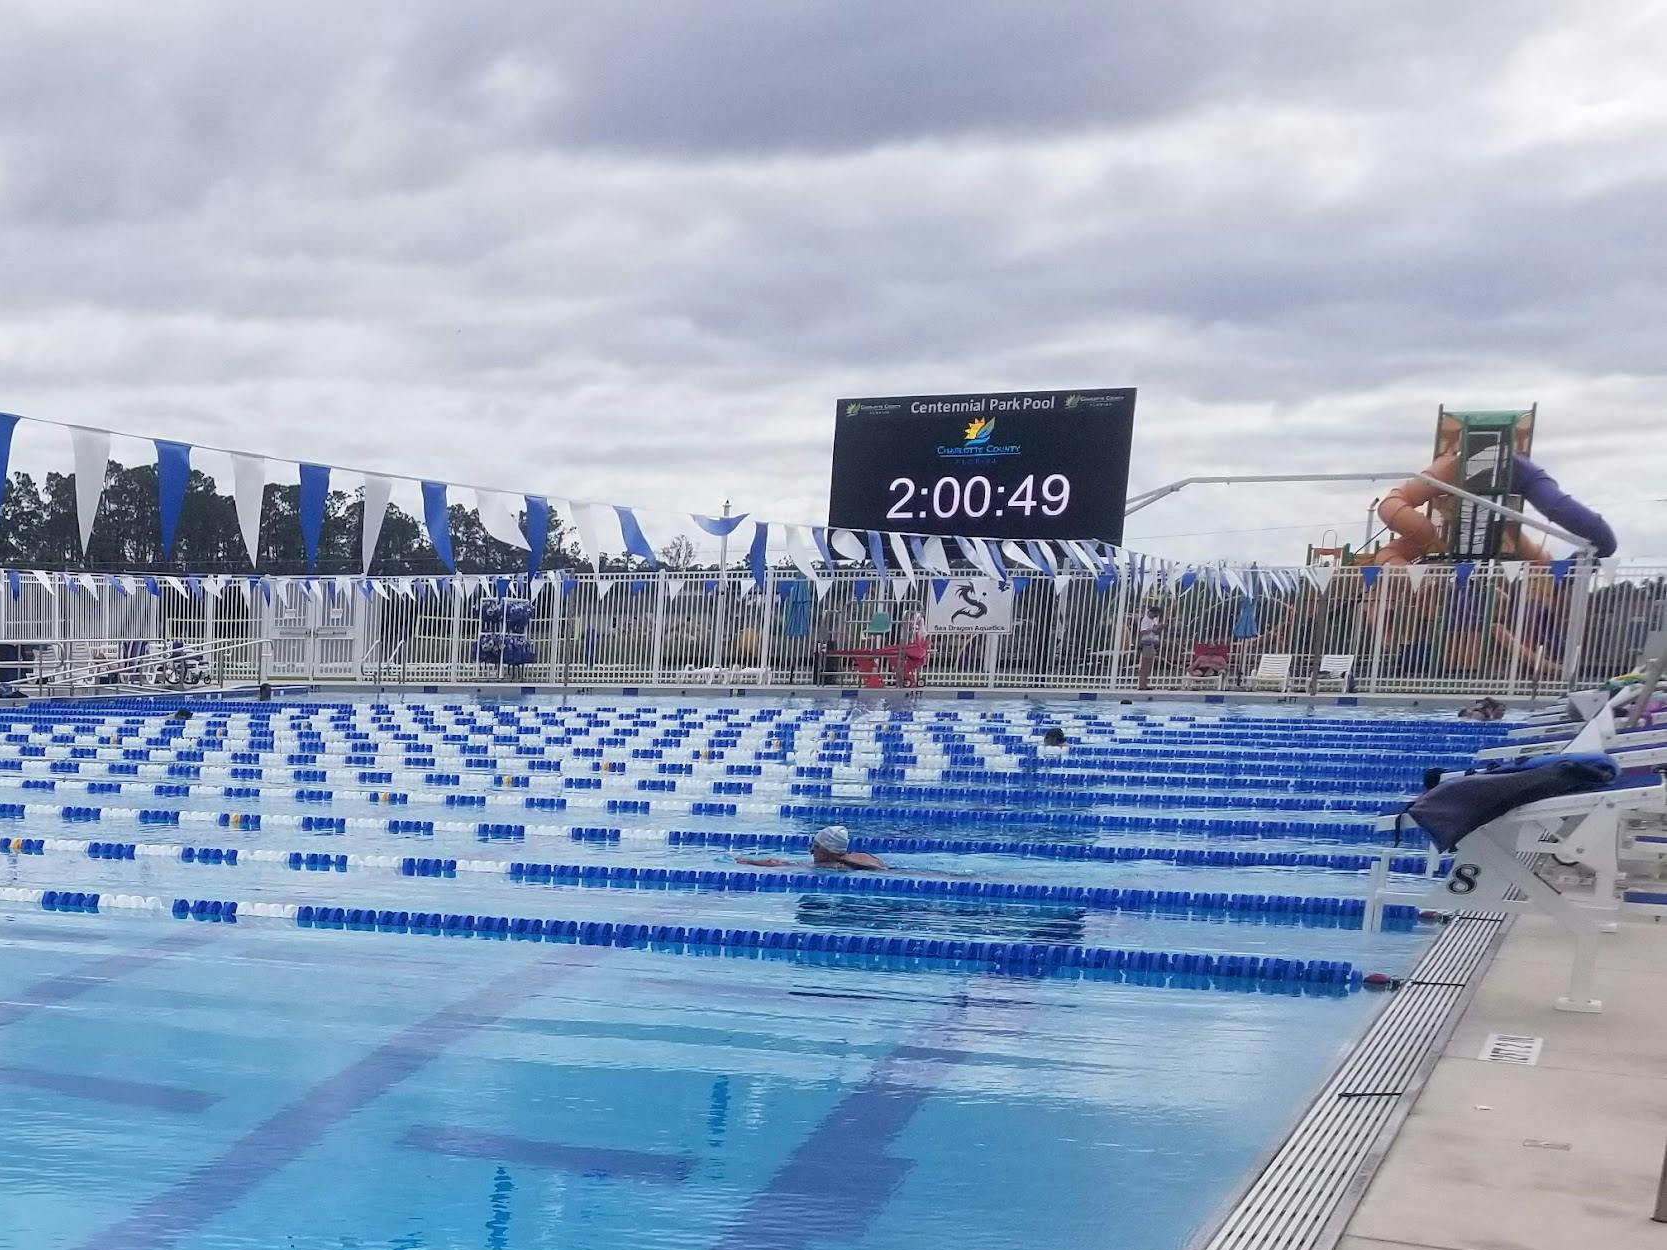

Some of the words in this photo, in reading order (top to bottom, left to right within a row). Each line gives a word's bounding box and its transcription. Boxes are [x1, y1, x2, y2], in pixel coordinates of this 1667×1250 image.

[910, 399, 986, 414] Centennial
[989, 397, 1021, 411] Park
[1023, 396, 1055, 410] Pool
[885, 473, 1071, 519] 2:00:49
[948, 624, 973, 632] Dragon
[974, 624, 1006, 632] Aquatics
[1446, 864, 1481, 895] 8
